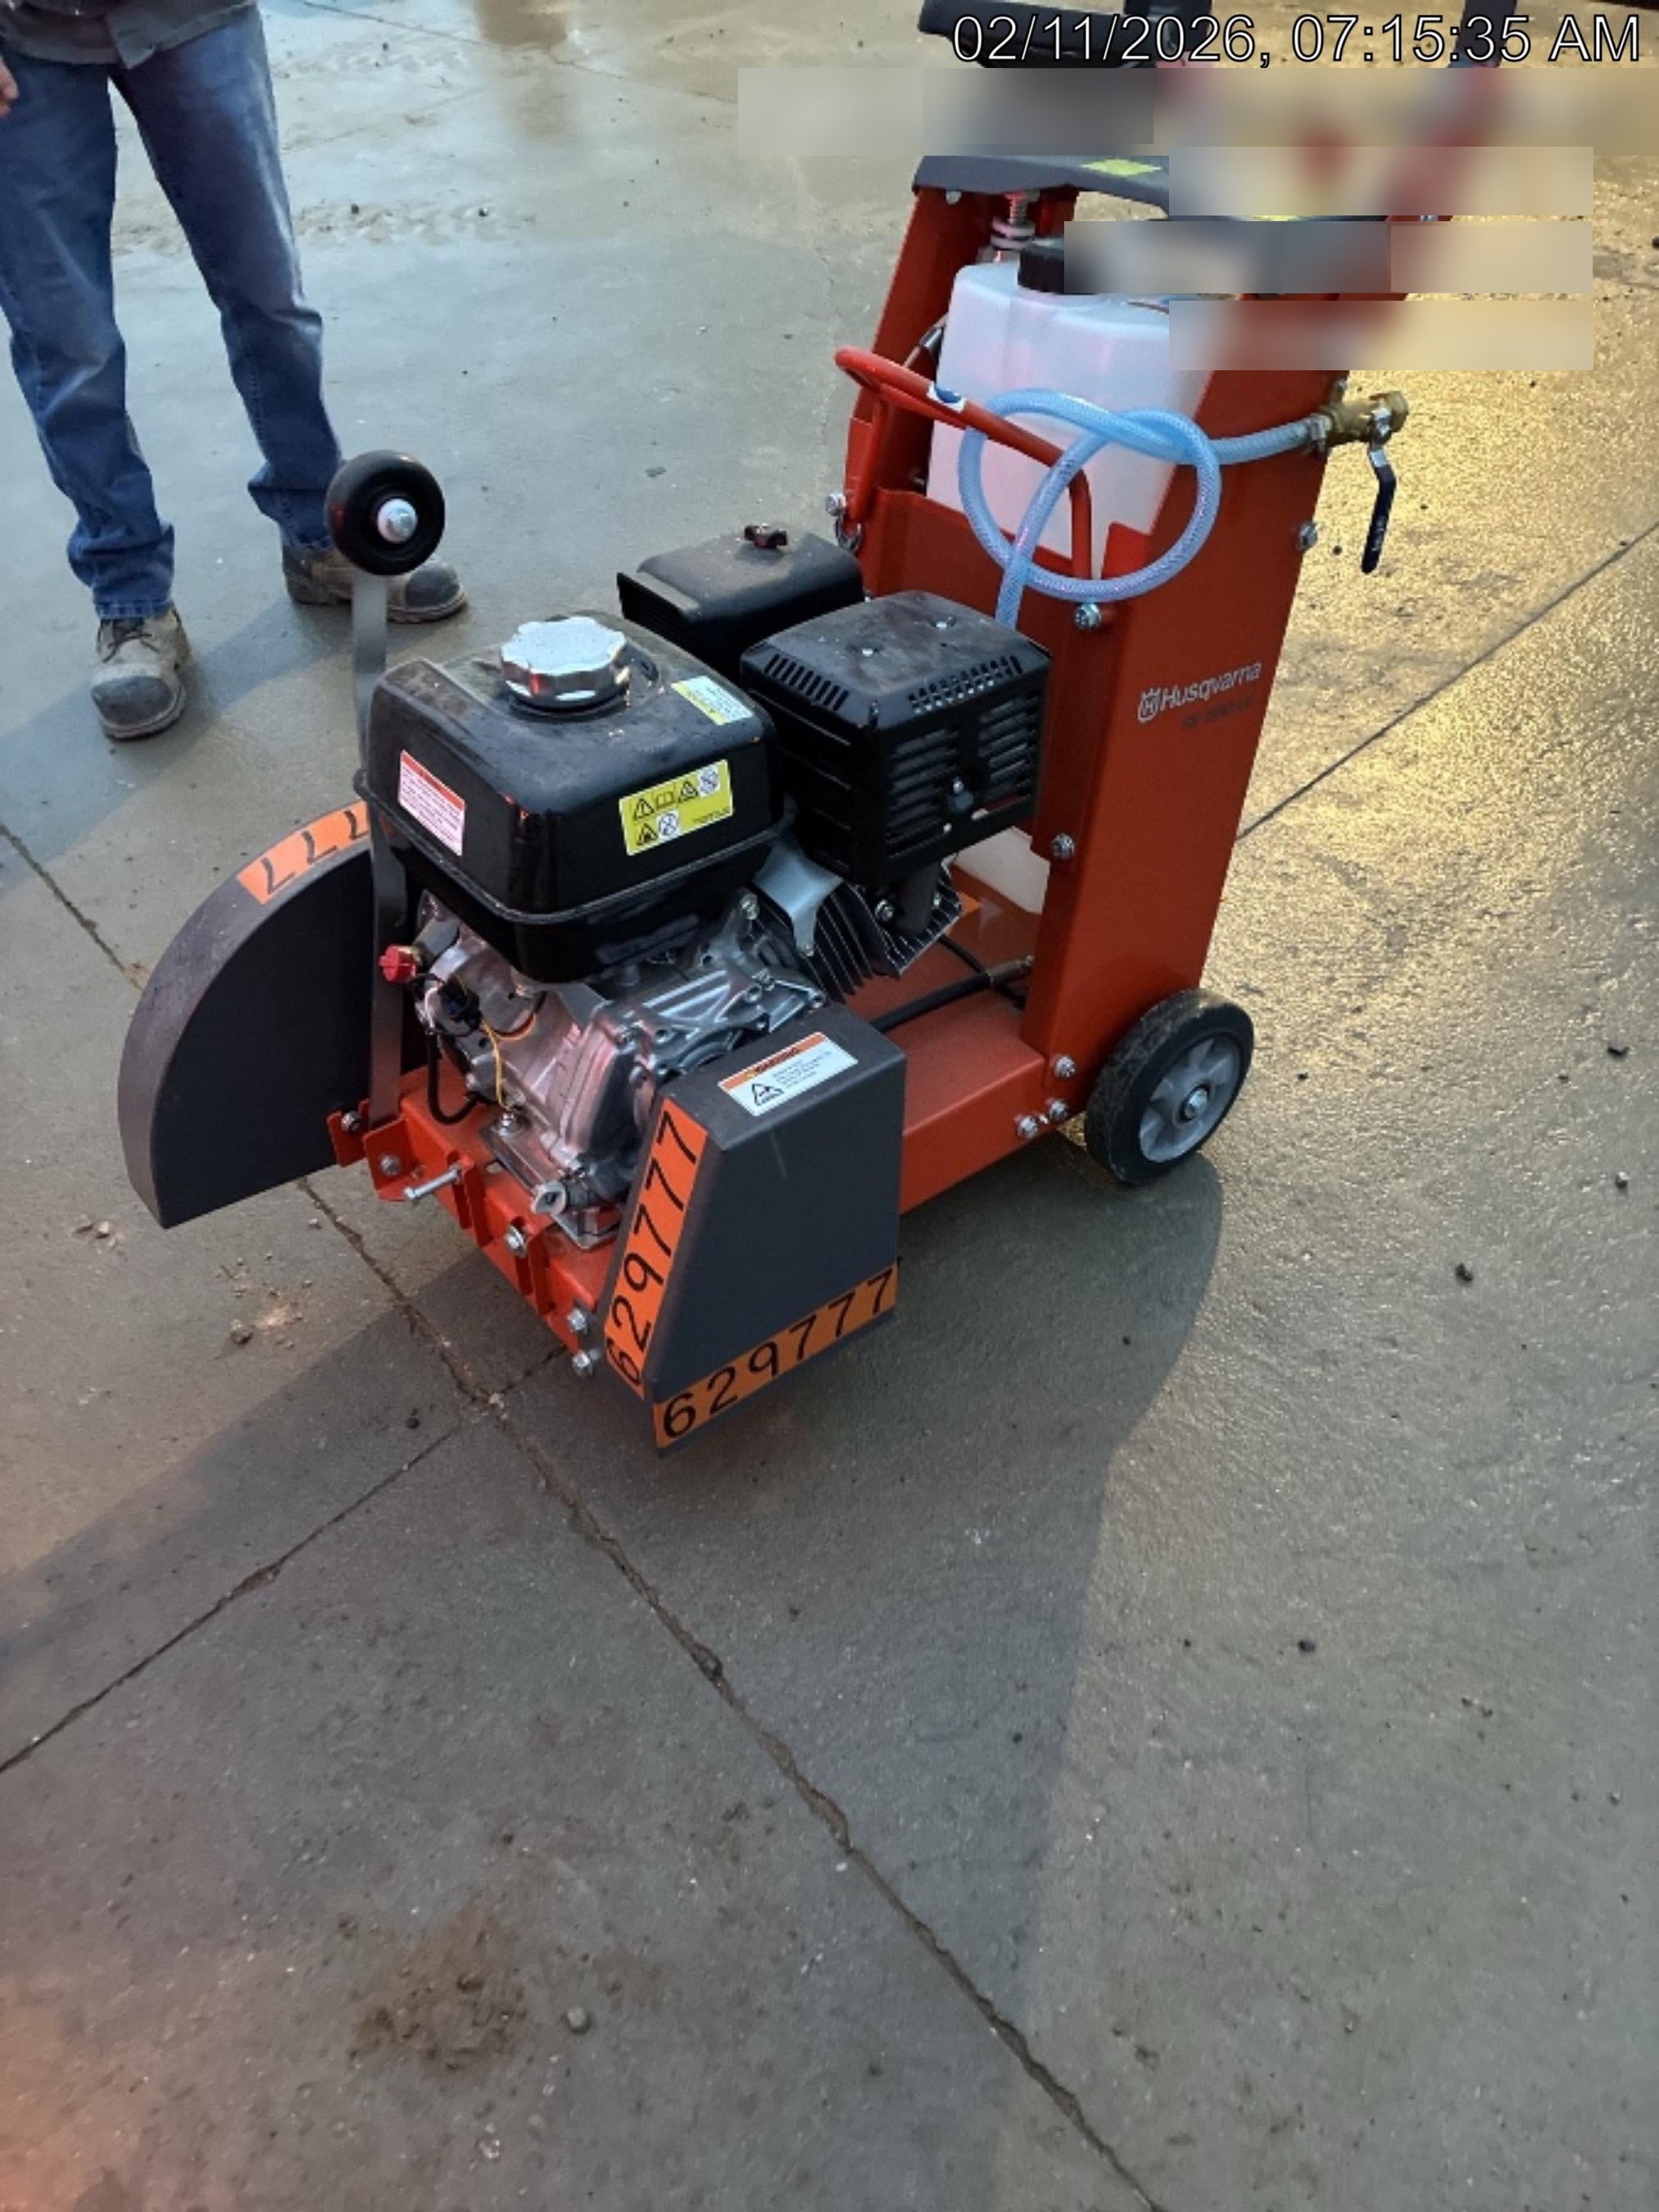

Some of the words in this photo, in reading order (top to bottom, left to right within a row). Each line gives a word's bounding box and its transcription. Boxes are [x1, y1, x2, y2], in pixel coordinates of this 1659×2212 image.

[1159, 662, 1262, 712] Husqvarna
[606, 1109, 697, 1386] 629777
[662, 1267, 894, 1439] 629777
